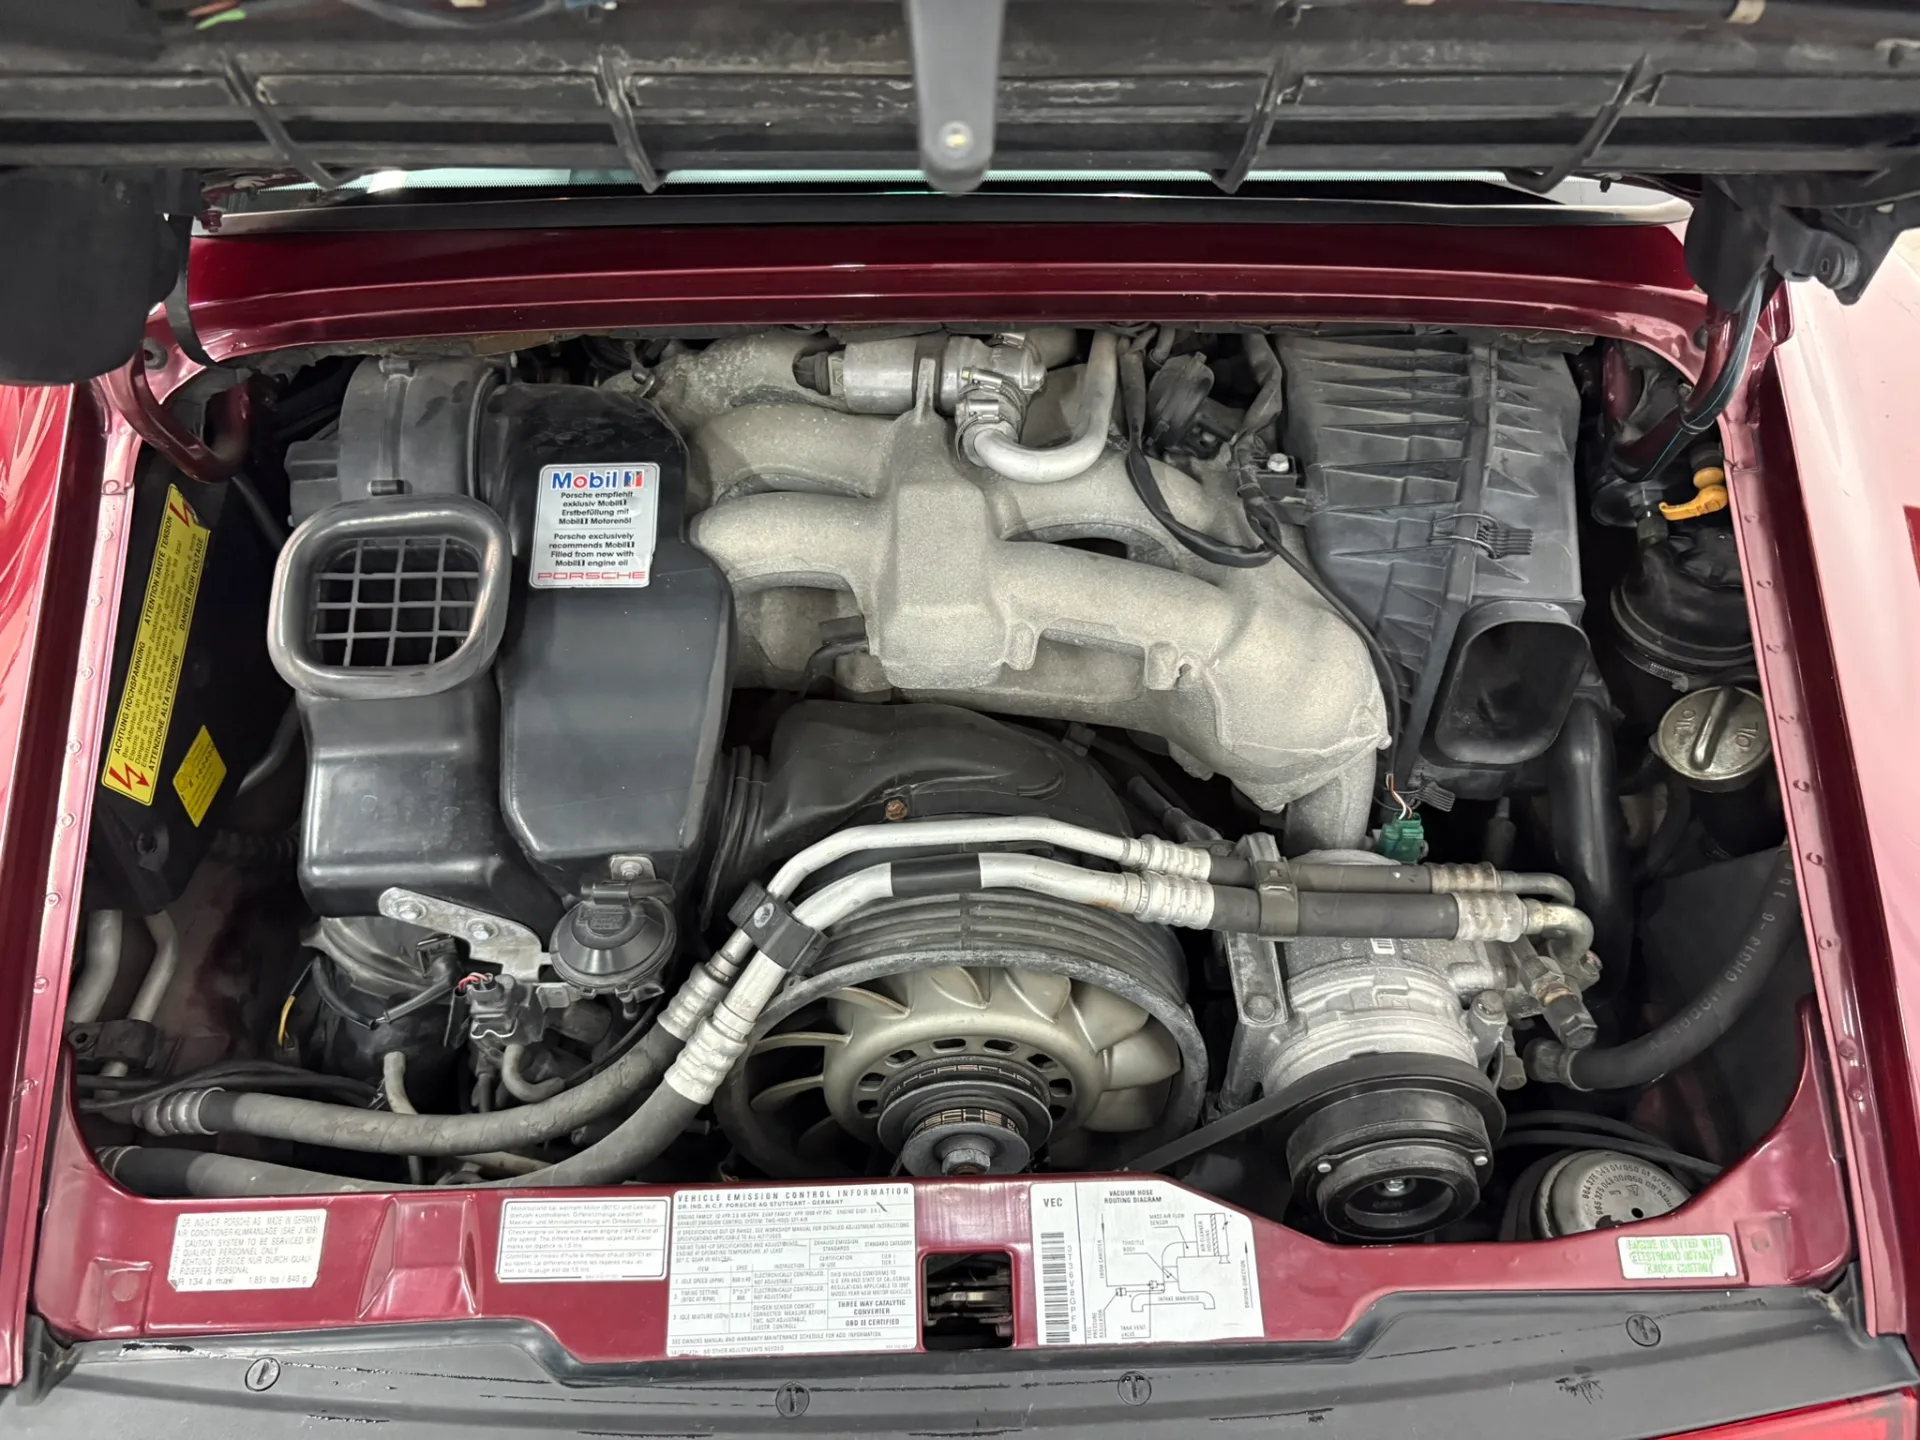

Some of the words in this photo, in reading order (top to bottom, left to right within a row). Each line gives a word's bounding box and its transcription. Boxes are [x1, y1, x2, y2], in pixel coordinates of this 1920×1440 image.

[552, 472, 617, 489] Mobil
[190, 537, 203, 574] VOLTAGE
[186, 574, 195, 595] HIGH
[178, 596, 191, 630] DANGER
[113, 710, 129, 755] ACHTUNG
[123, 640, 145, 711] HOCHSPANNUNG
[143, 578, 159, 625] ATTENTION
[153, 550, 165, 578] HAUTE
[160, 515, 173, 549] TENSION
[165, 653, 179, 694] TENSIONE
[128, 733, 140, 762] Electric
[135, 708, 145, 730] shock
[148, 654, 157, 673] when
[153, 624, 164, 651] working
[160, 694, 170, 717] ALTA
[125, 710, 138, 742] Arbeiten
[133, 697, 141, 708] an
[144, 704, 153, 722] mort
[141, 724, 149, 735] de
[1735, 722, 1758, 750] OIL
[135, 737, 146, 765] Danger
[148, 718, 165, 772] ATTENZIONE
[678, 1193, 720, 1202] VEHICLE
[727, 1191, 778, 1200] EMISSION
[785, 1190, 830, 1198] CONTROL
[837, 1186, 908, 1197] INFORMATION
[1043, 1197, 1063, 1208] VEC
[217, 1238, 244, 1246] SYSTEM
[246, 1237, 256, 1246] TO
[188, 1277, 203, 1286] 134
